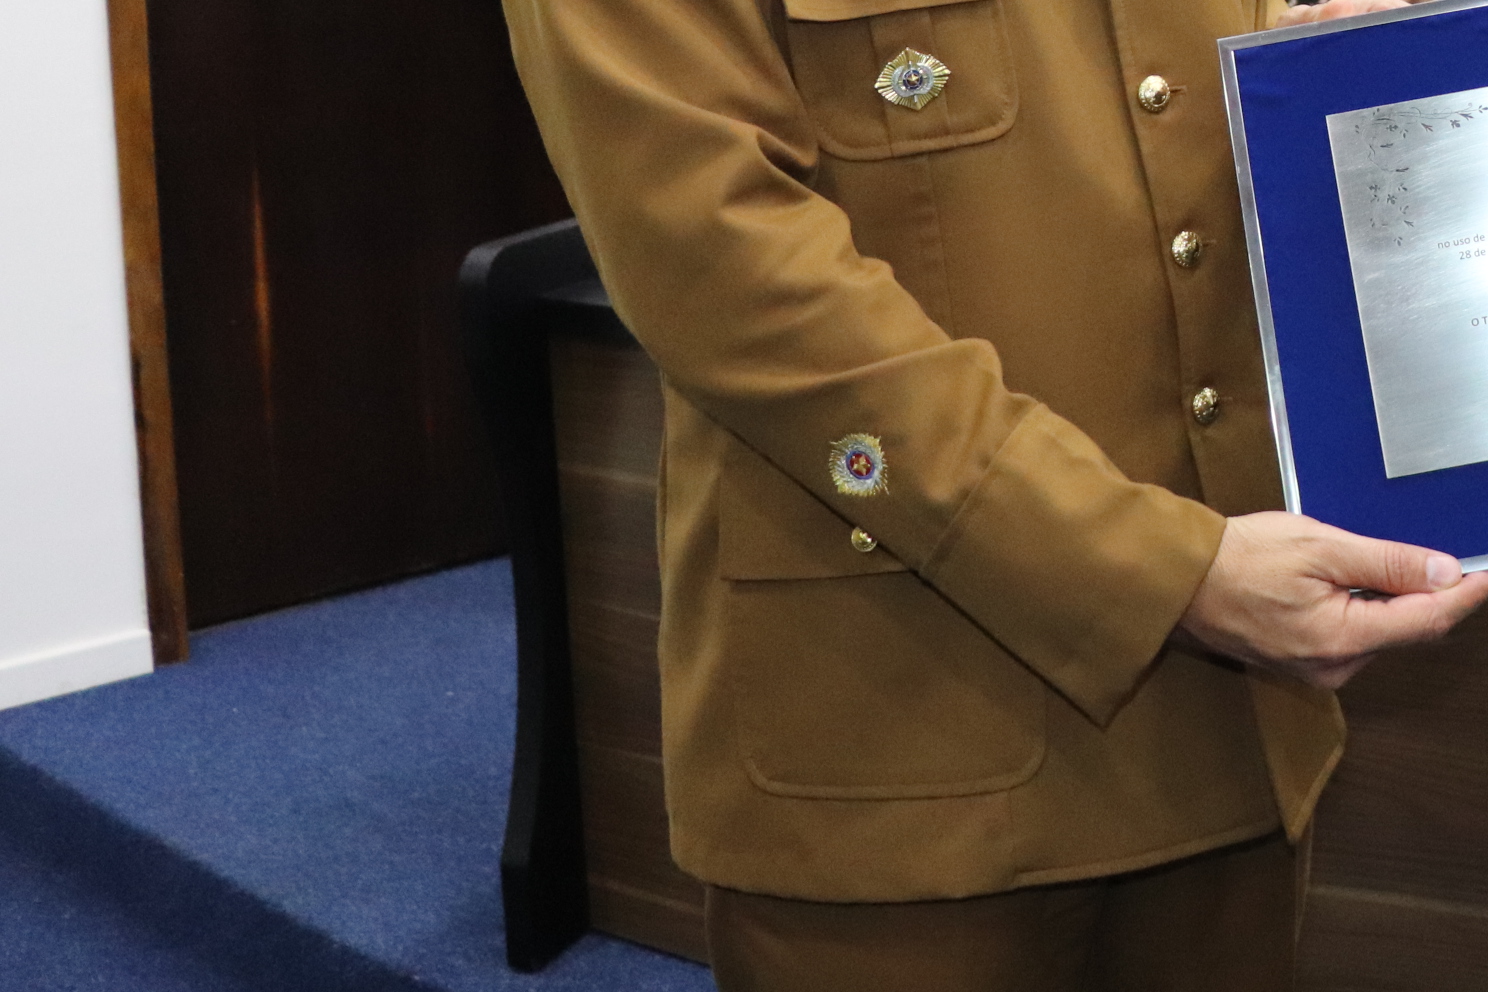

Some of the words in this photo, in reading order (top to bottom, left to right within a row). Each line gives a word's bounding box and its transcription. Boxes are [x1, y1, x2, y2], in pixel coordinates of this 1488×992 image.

[1437, 240, 1451, 249] no
[1452, 236, 1470, 246] uso
[1472, 233, 1485, 242] de
[1459, 249, 1471, 260] 28
[1473, 247, 1486, 257] de
[1470, 317, 1480, 327] O
